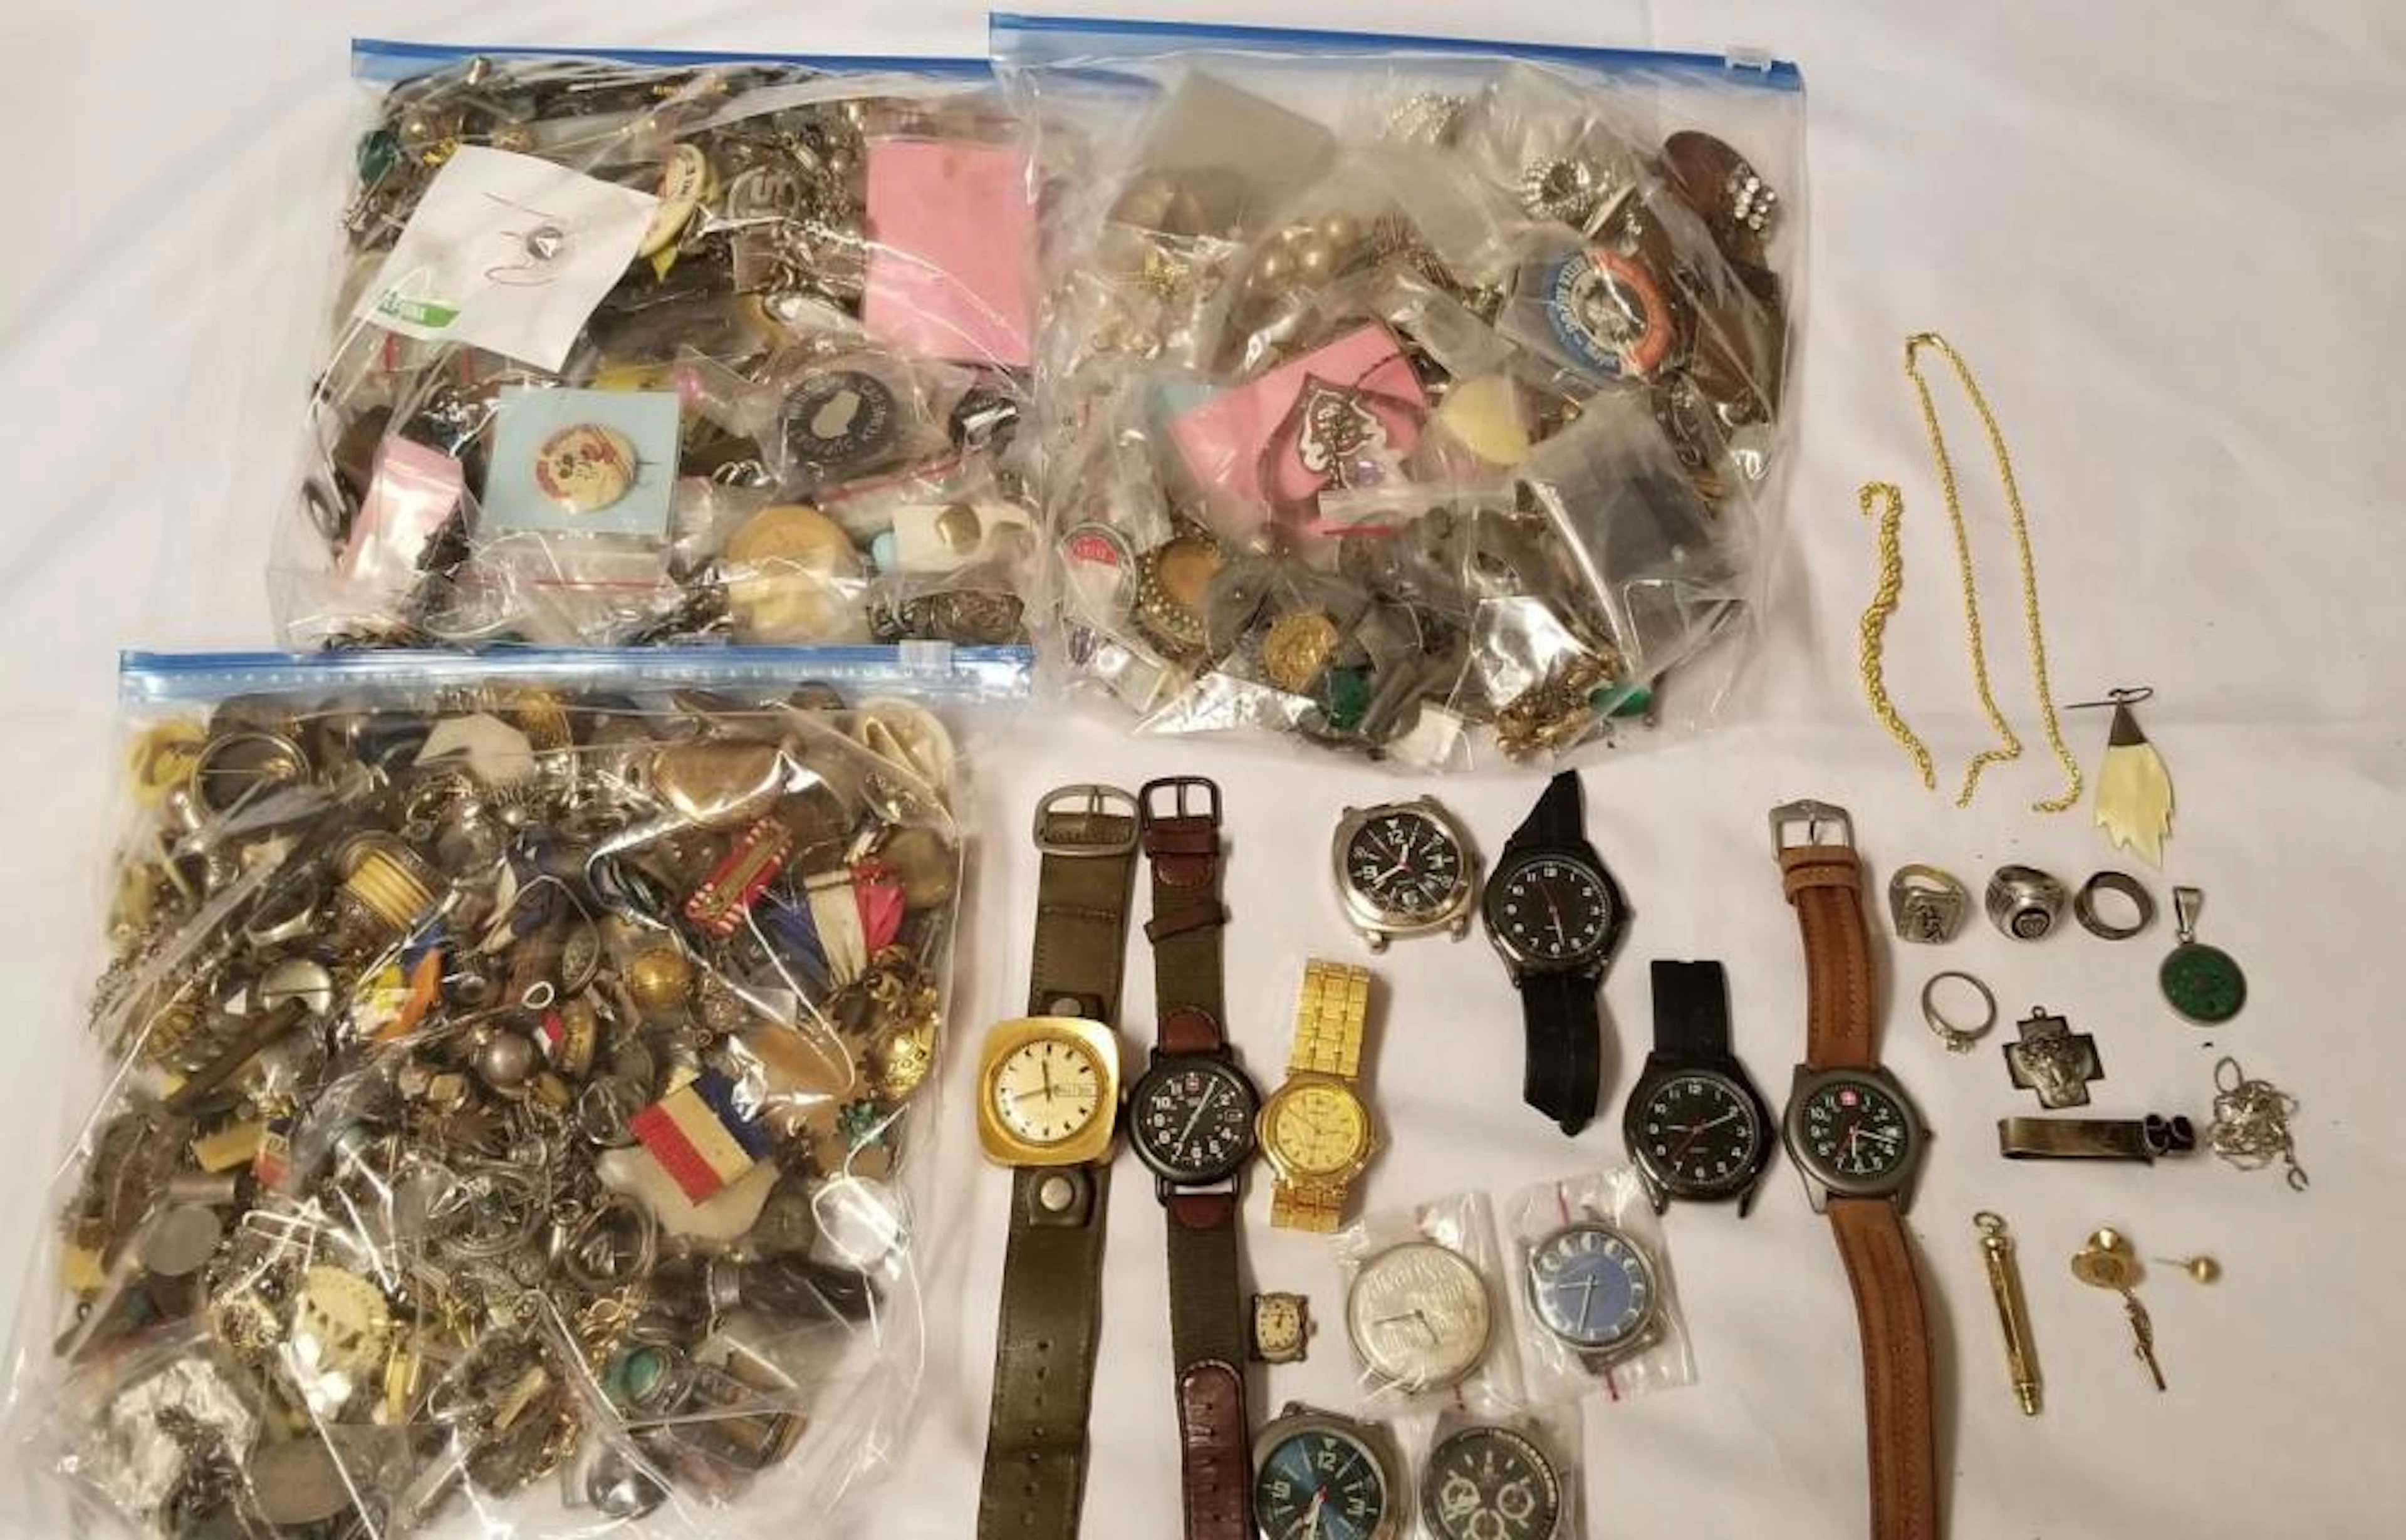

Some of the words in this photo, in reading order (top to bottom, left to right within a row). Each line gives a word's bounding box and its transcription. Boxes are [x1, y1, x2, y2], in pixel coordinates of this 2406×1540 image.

[1387, 829, 1405, 845] 12
[1529, 937, 1539, 948] 7
[1688, 1083, 1702, 1095] 12
[1156, 1096, 1170, 1110] 10
[1221, 1094, 1230, 1106] 2
[1654, 1103, 1667, 1115] 10
[1810, 1105, 1825, 1120] 10
[1878, 1108, 1890, 1121] 2
[1221, 1128, 1232, 1140] 4
[1731, 1146, 1741, 1158] 4
[1674, 1160, 1683, 1172] 7
[1318, 1450, 1337, 1472] 12
[1271, 1479, 1291, 1501] 9
[1346, 1497, 1365, 1517] 3
